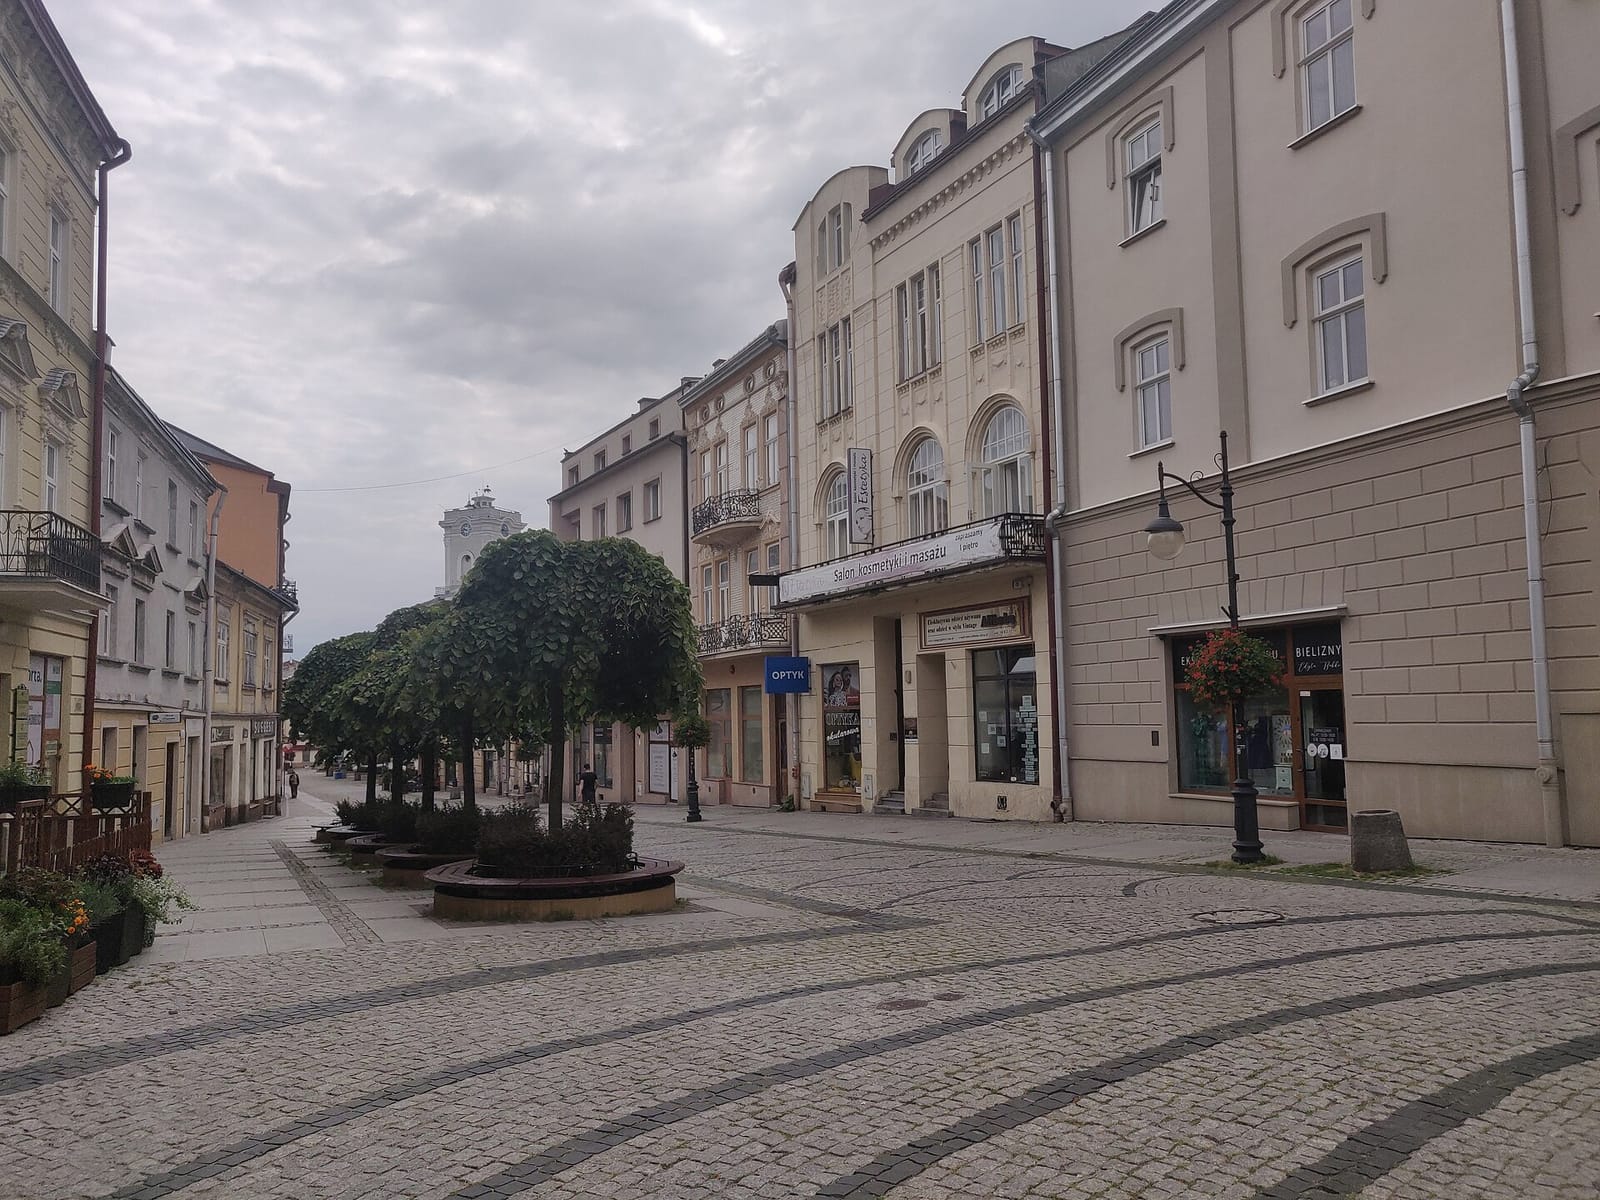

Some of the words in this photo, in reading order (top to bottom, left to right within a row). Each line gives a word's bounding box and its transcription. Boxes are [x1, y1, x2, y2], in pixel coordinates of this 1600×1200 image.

[857, 454, 869, 504] Estetyka
[955, 529, 984, 541] zapraszamy
[962, 541, 979, 552] piętro
[834, 567, 855, 582] Salon
[858, 553, 902, 577] kosmetyki
[909, 544, 947, 564] masażu
[1296, 644, 1342, 658] BIELIZNY
[772, 671, 804, 680] OPTYK
[825, 712, 859, 725] OPTYKA
[826, 727, 859, 741] okularowa
